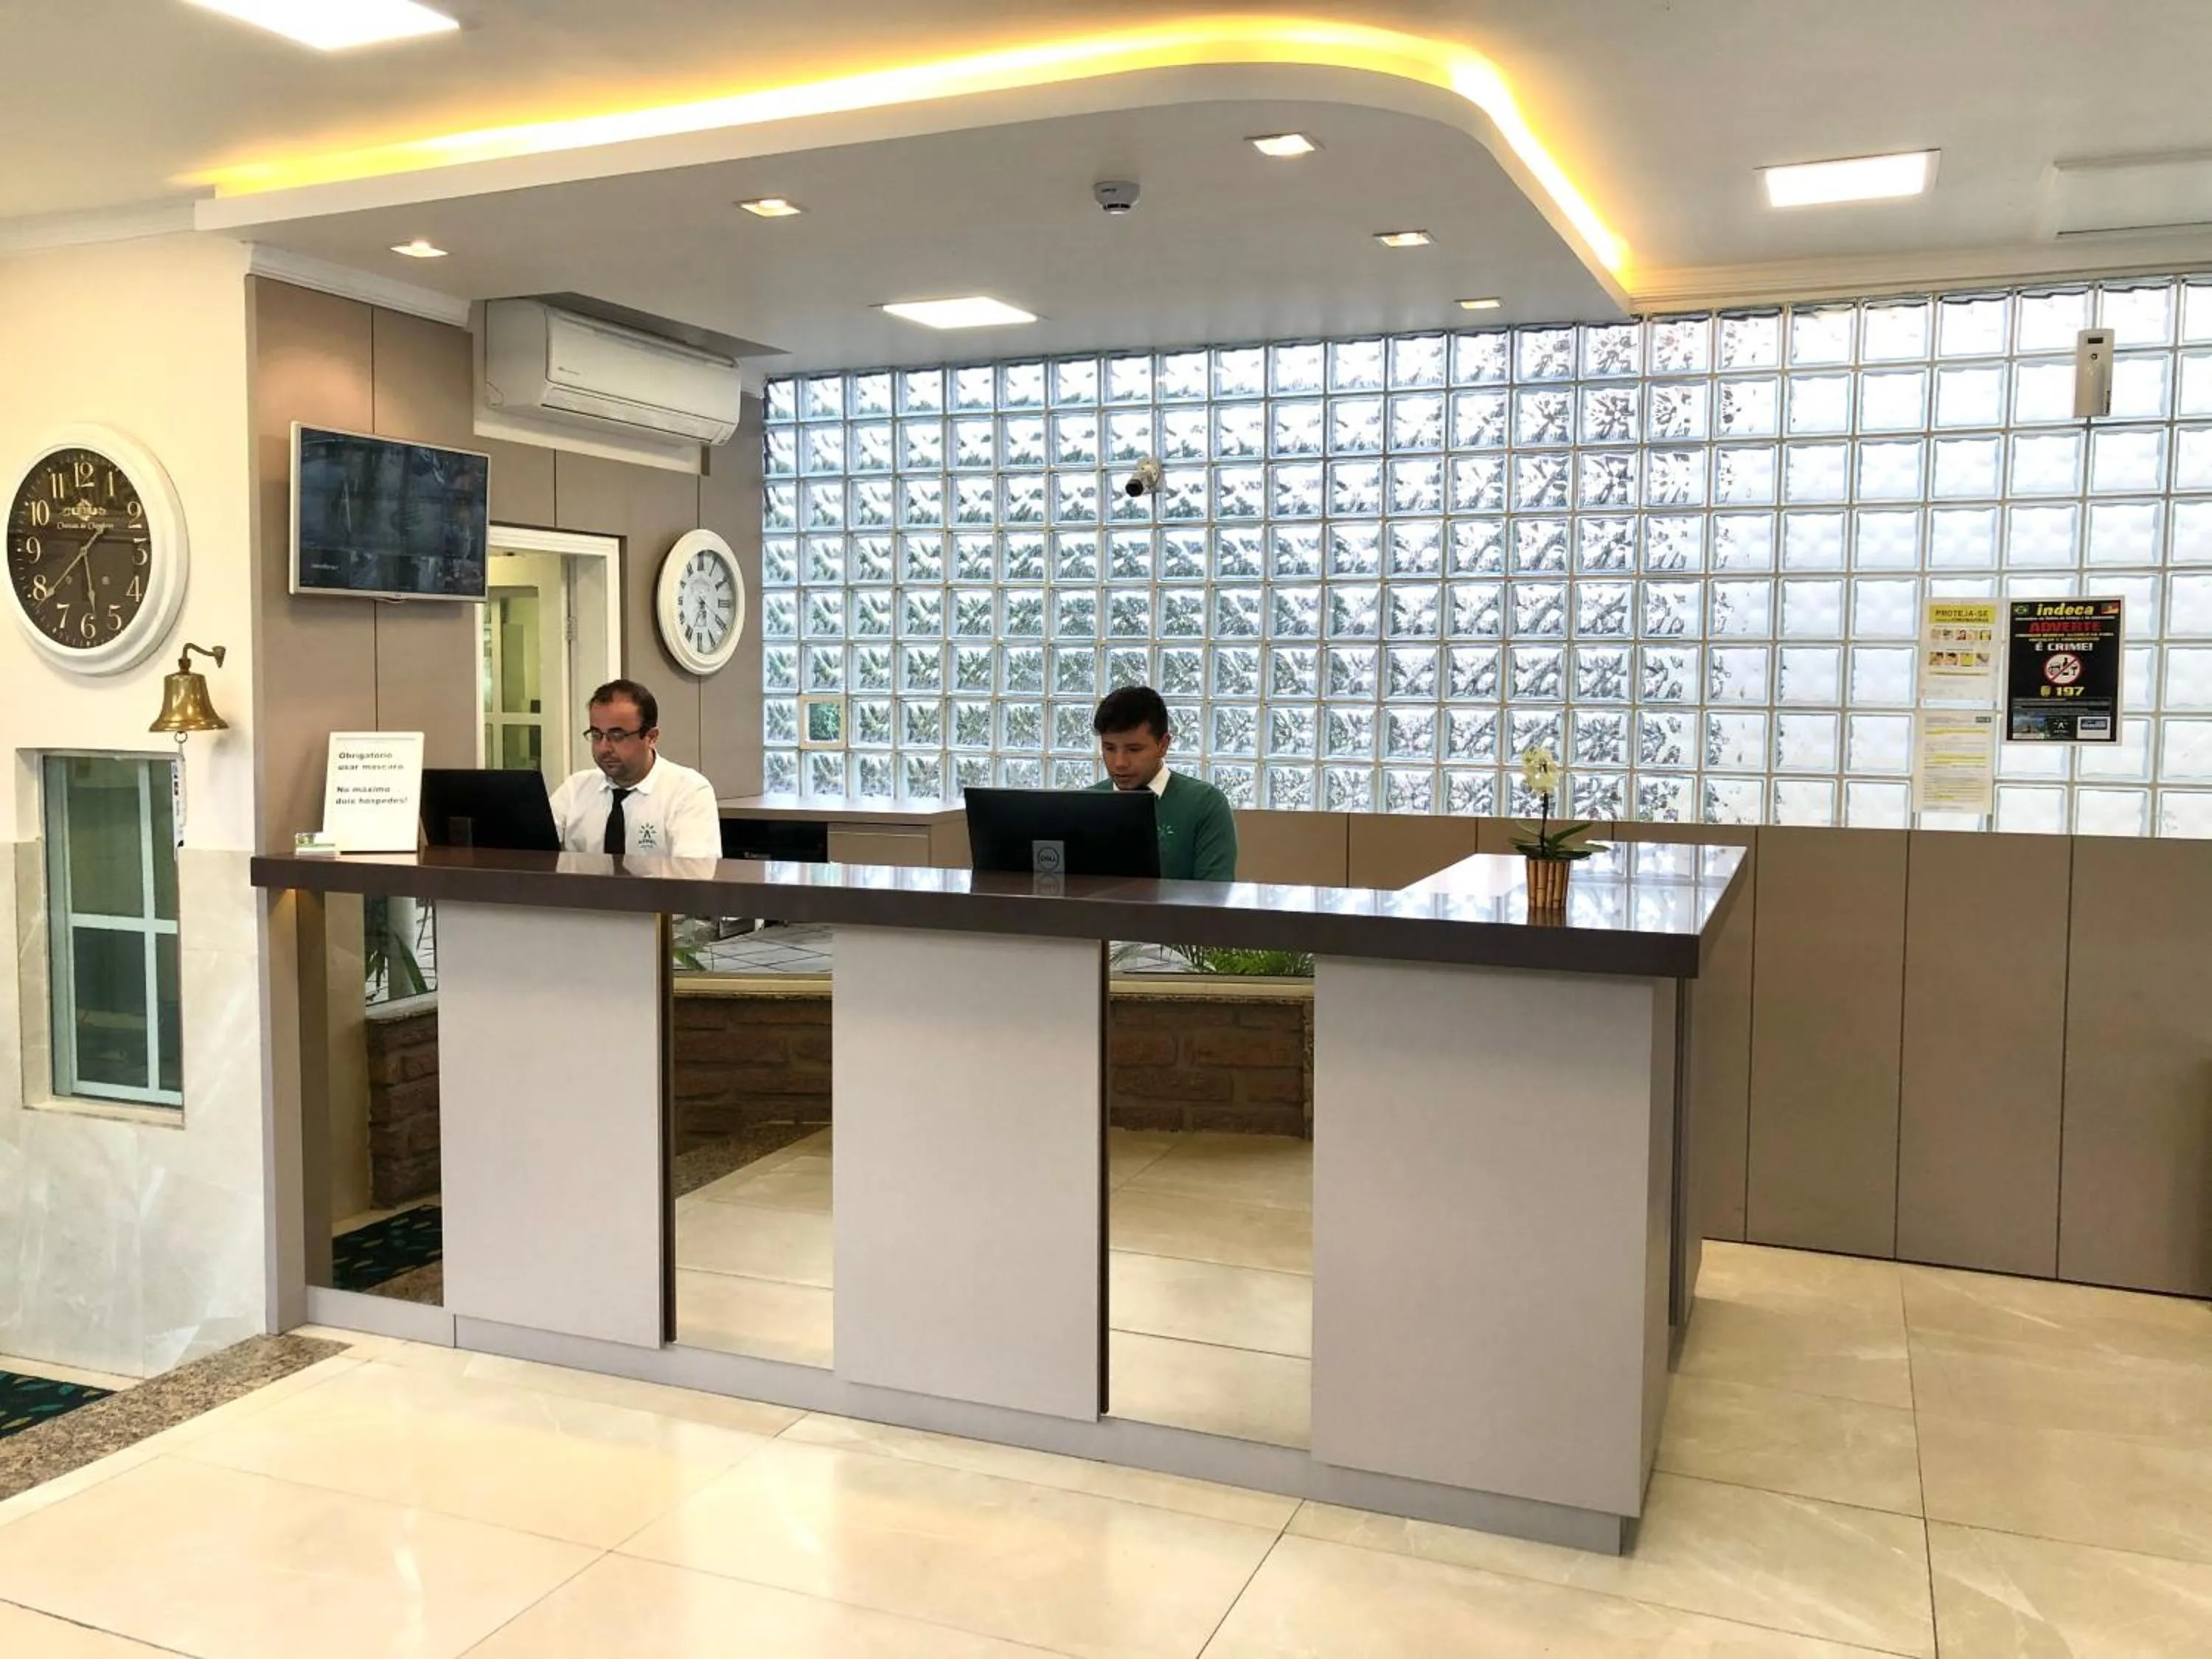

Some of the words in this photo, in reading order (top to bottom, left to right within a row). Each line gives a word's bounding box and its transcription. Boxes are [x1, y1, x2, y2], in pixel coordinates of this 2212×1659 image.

[52, 473, 64, 498] 11
[74, 462, 94, 487] 12
[108, 470, 114, 496] 1
[31, 500, 50, 526] 10
[128, 501, 142, 529] 2
[26, 536, 41, 564] 9
[132, 538, 147, 566] 3
[33, 574, 47, 601] 8
[126, 575, 142, 602] 4
[57, 603, 70, 629] 7
[80, 613, 97, 639] 6
[108, 605, 122, 630] 5
[2029, 621, 2101, 633] ADVERTE
[2056, 686, 2084, 697] 197
